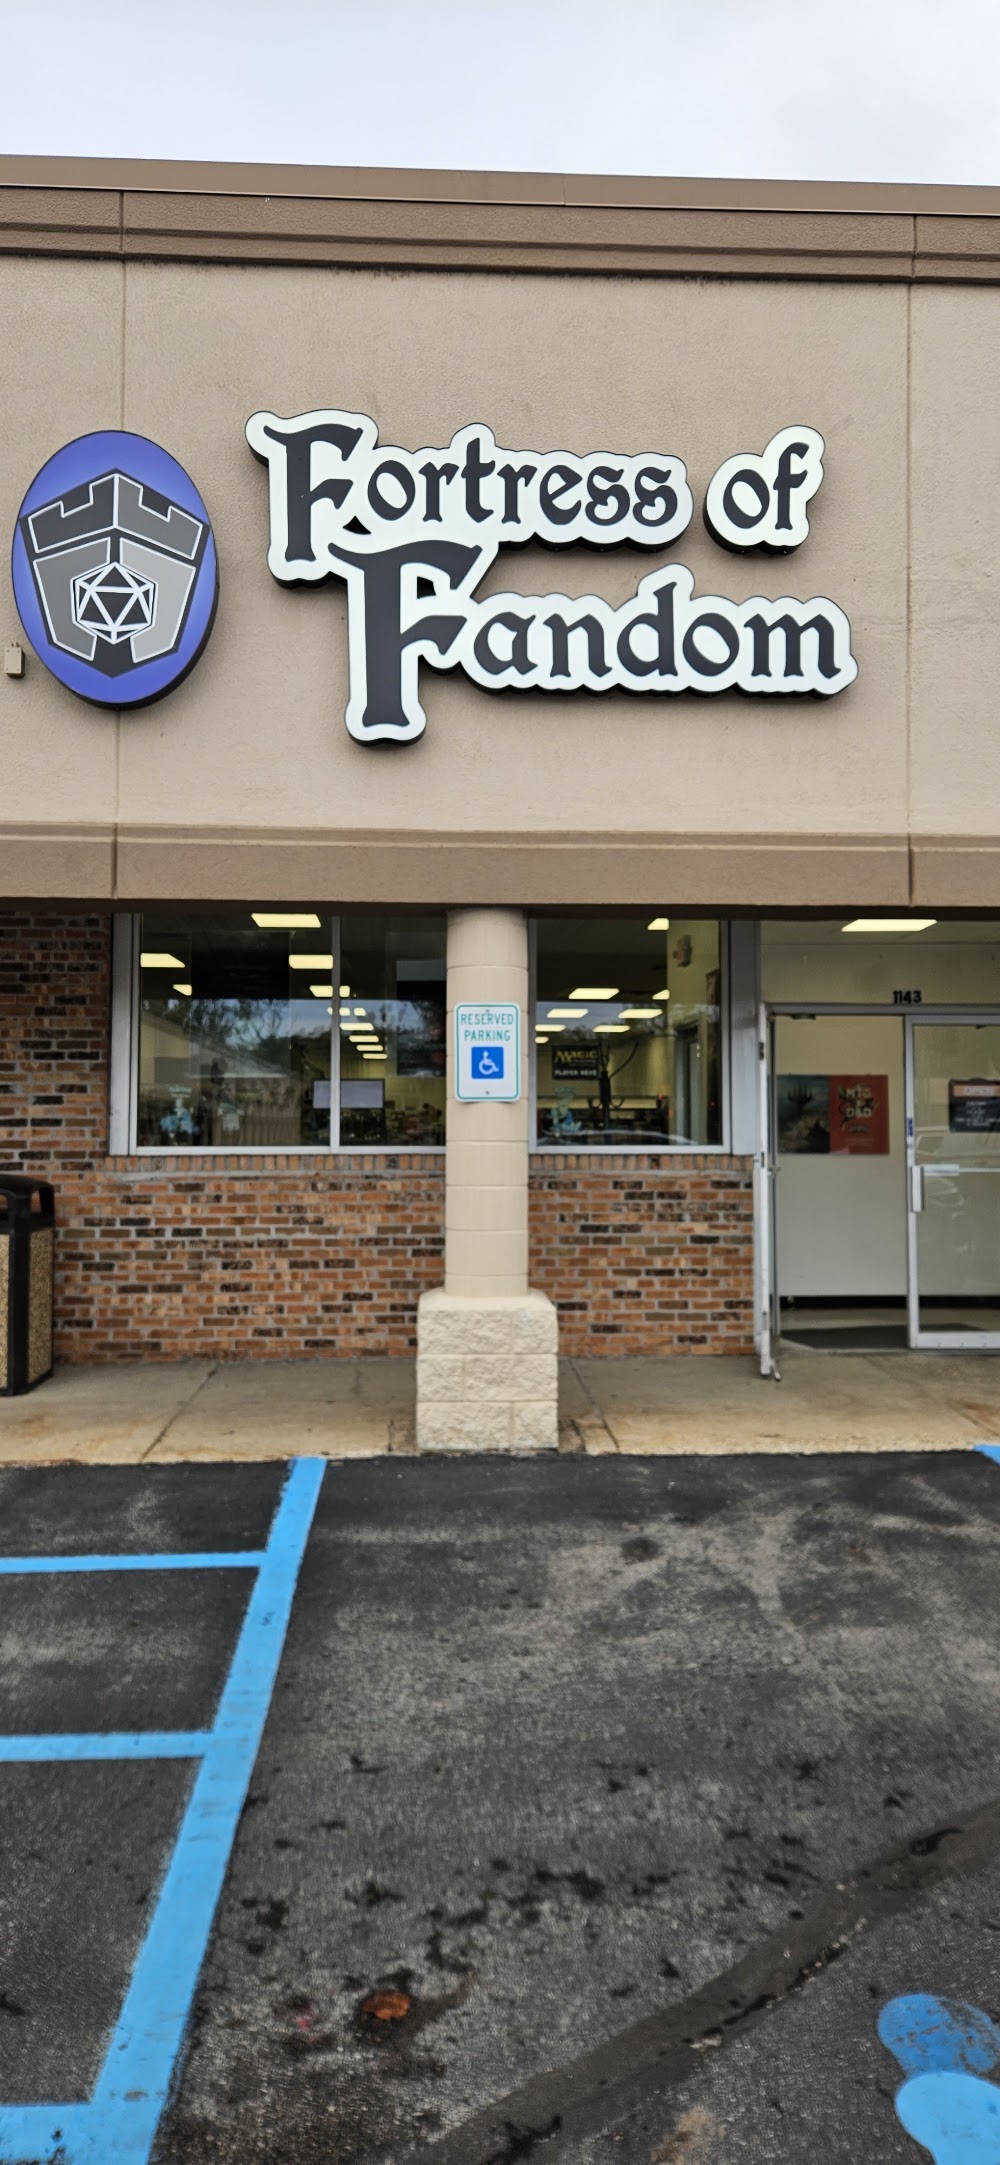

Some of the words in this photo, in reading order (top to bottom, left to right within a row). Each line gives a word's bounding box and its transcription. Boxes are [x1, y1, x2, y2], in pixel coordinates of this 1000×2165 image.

[263, 423, 678, 562] Fortress
[723, 442, 809, 530] of
[328, 540, 841, 727] Fandom
[893, 990, 922, 1004] 1143
[461, 1013, 514, 1025] RESERVED
[464, 1030, 511, 1041] PARKING
[554, 1050, 598, 1062] MAGIC
